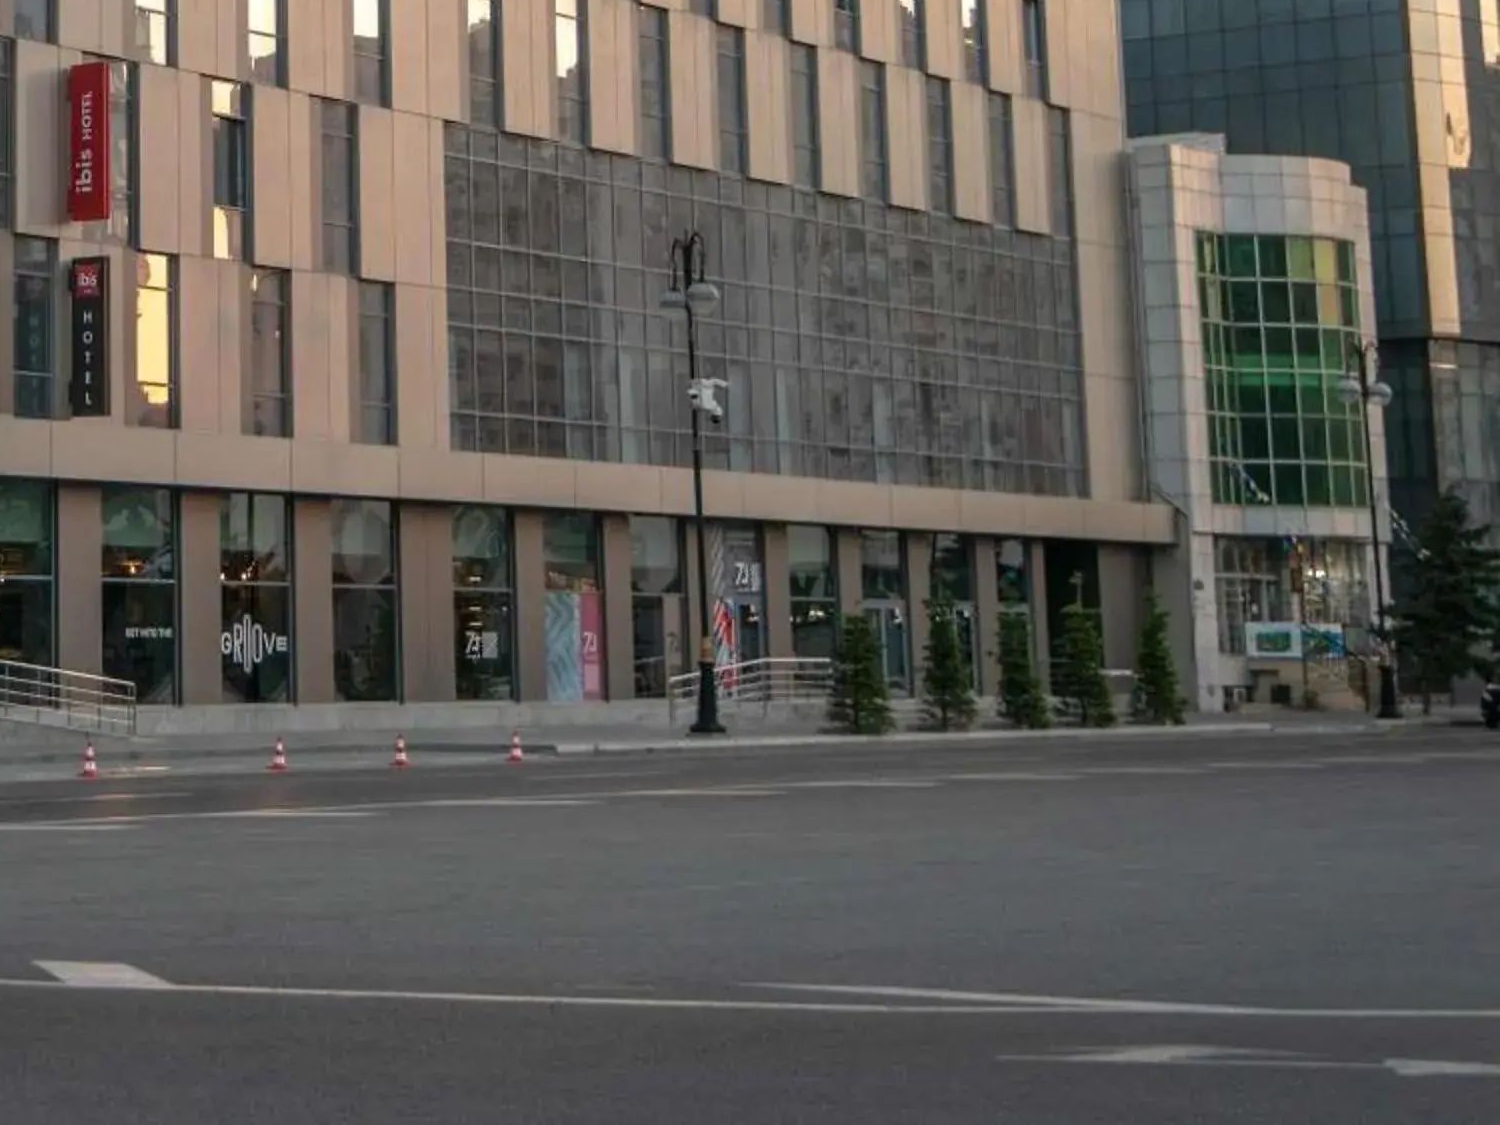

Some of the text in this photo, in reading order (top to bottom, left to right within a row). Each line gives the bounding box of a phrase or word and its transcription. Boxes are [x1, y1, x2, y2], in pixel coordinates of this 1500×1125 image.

[75, 91, 93, 194] ibis HOTEL
[77, 272, 98, 287] ibis
[82, 310, 94, 406] HOTEL
[221, 614, 288, 673] GROOVE
